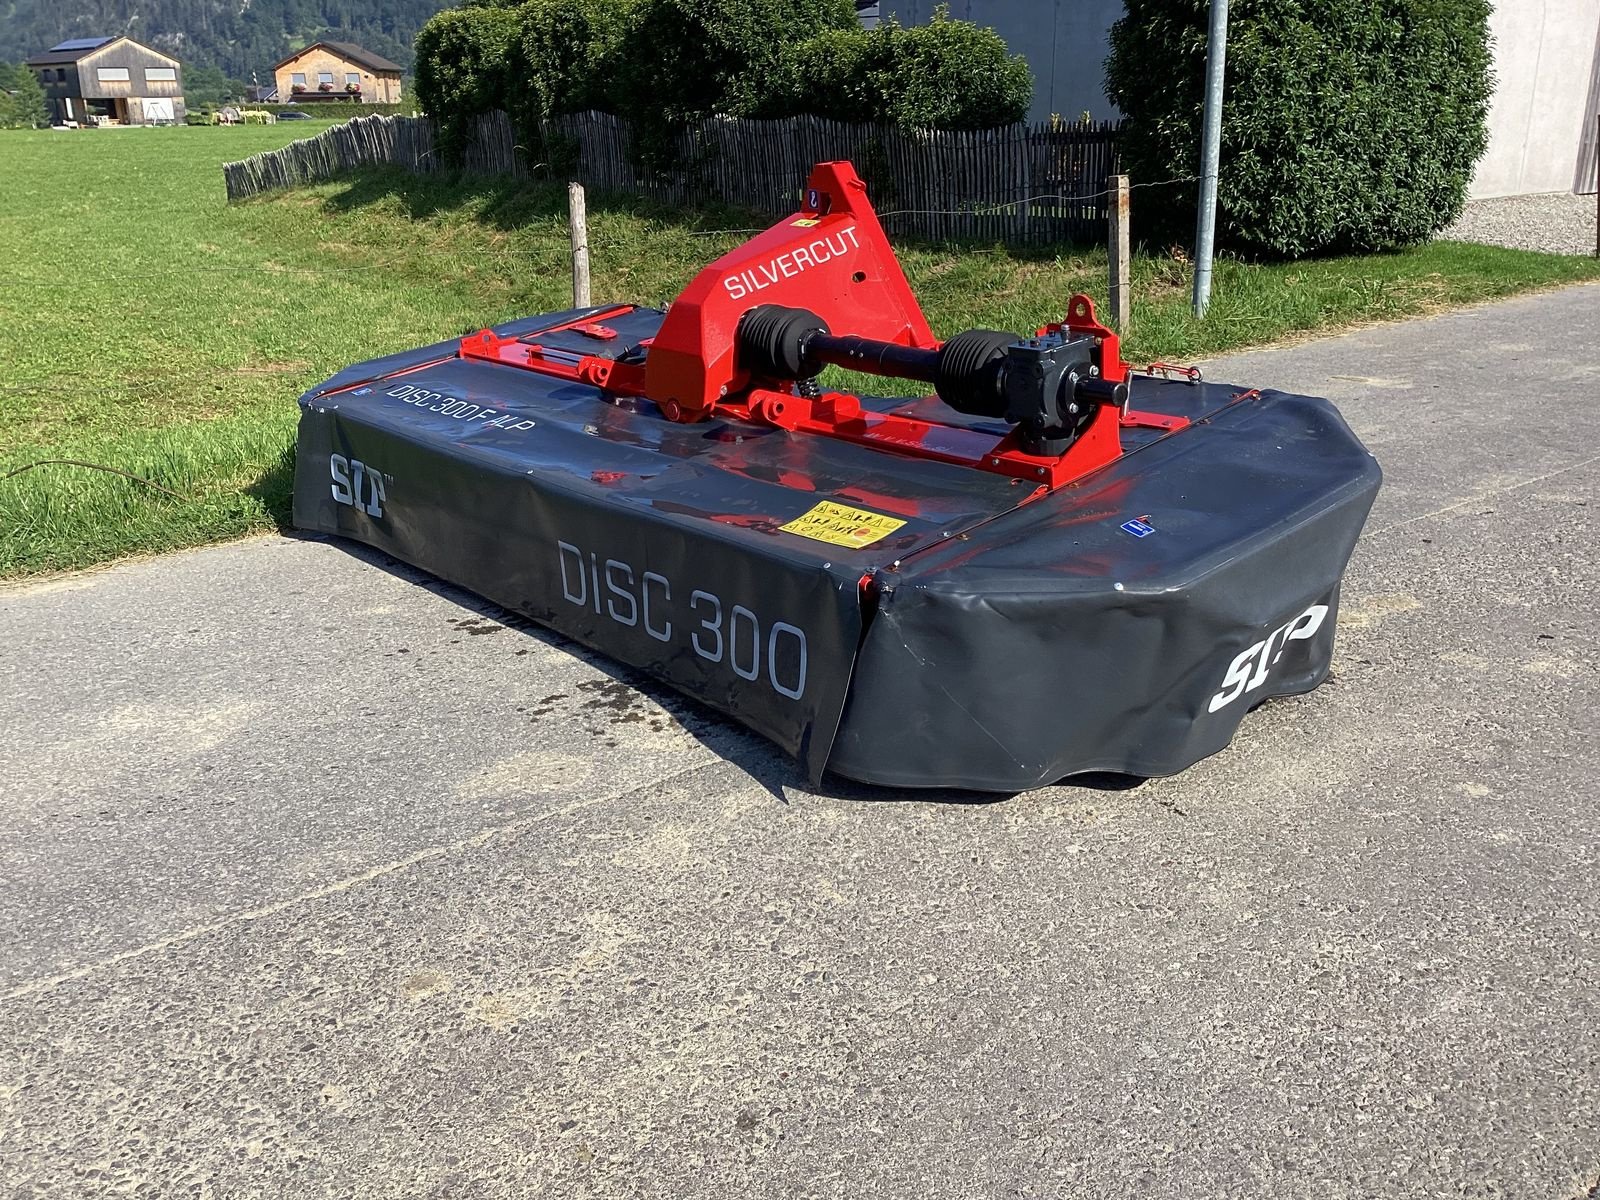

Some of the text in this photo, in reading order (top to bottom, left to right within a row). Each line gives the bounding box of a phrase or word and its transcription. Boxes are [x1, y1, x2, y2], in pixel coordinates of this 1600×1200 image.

[723, 226, 860, 300] SILVERCUT
[386, 384, 536, 431] DISC 300 F ALP
[557, 540, 808, 701] DISC 300
[1207, 604, 1329, 714] SIP
